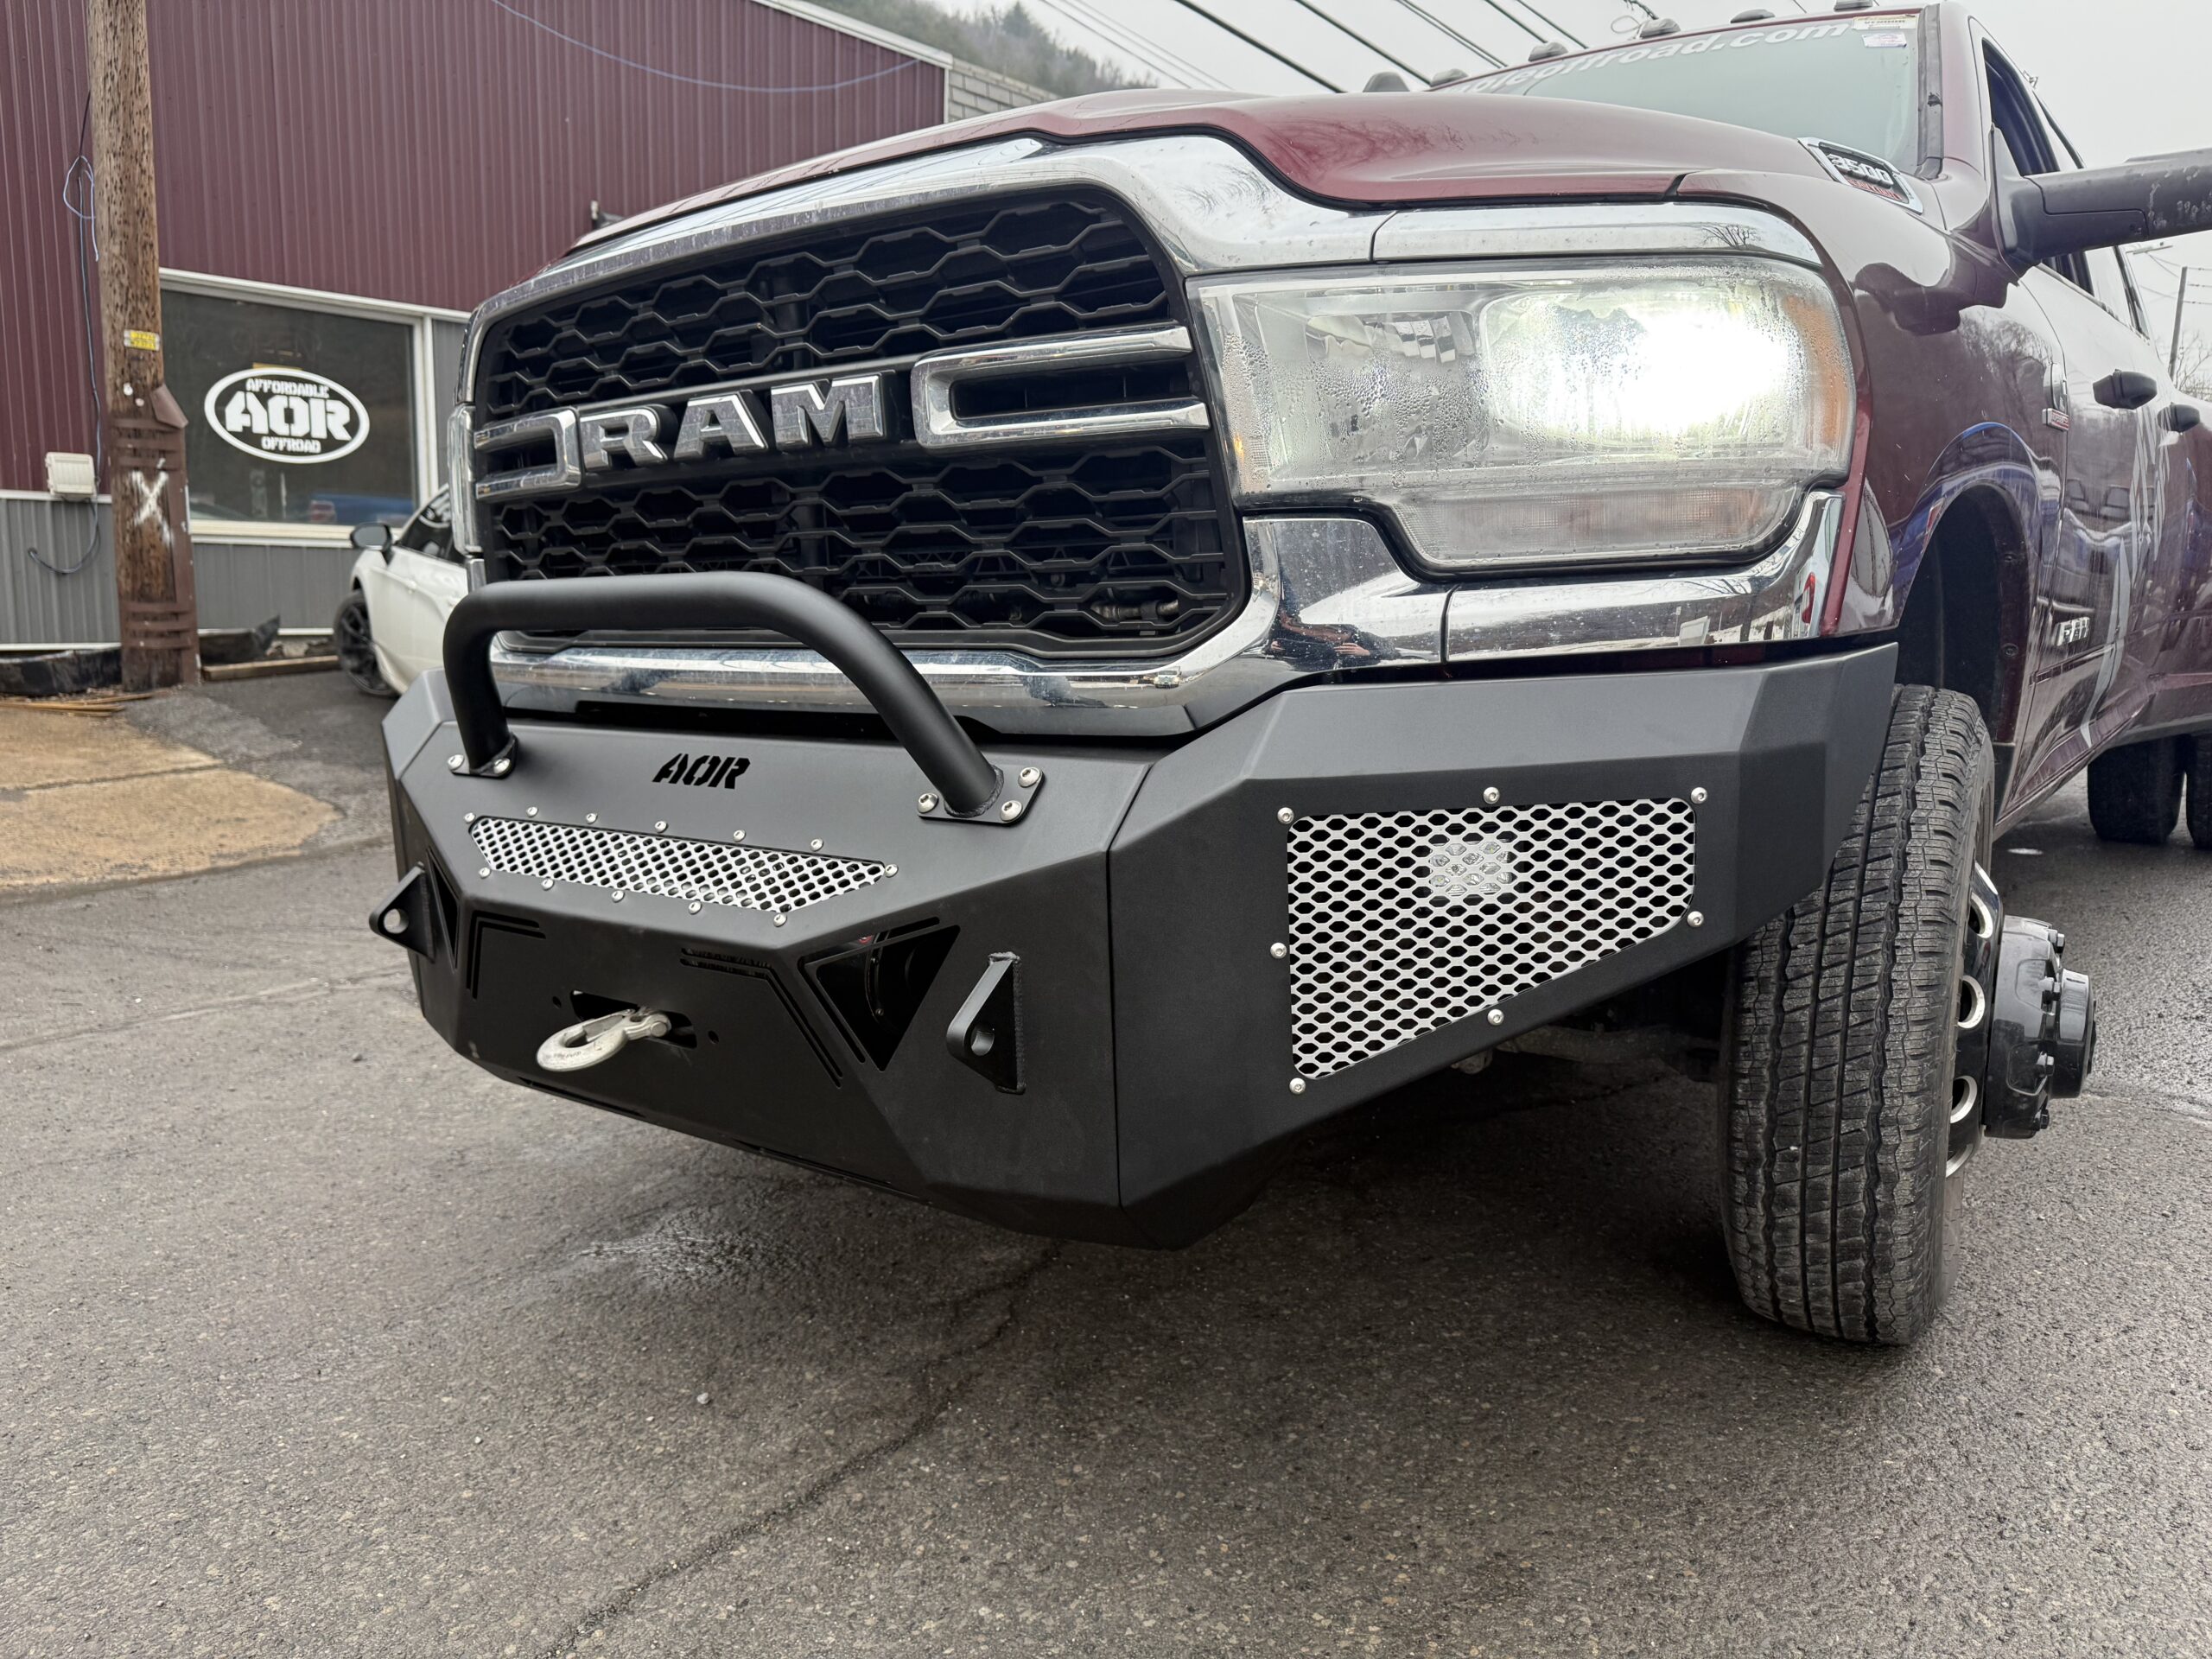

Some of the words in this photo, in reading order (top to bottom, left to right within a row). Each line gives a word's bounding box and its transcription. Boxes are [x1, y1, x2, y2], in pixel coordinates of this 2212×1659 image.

[245, 378, 331, 399] AFFORDABLE
[224, 391, 353, 442] AOR
[579, 374, 885, 474] RAM
[261, 435, 322, 454] OFFROAD
[652, 753, 751, 790] AOR
